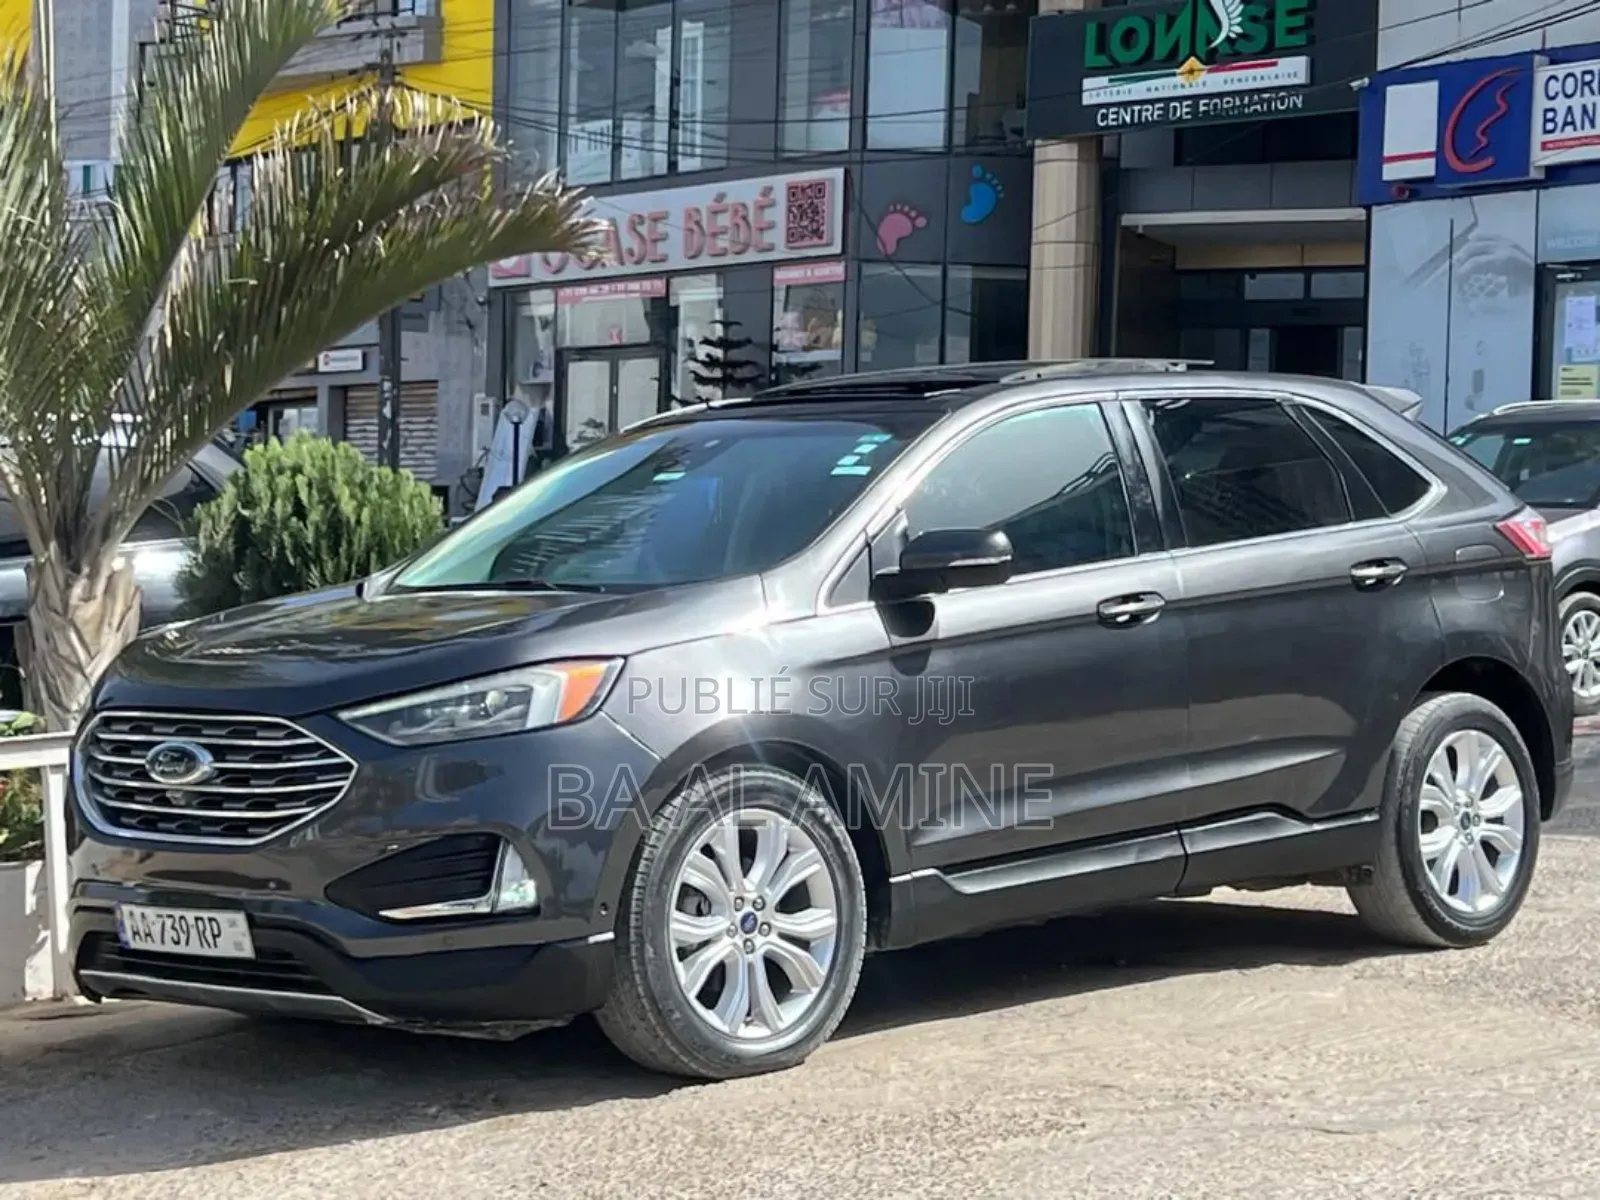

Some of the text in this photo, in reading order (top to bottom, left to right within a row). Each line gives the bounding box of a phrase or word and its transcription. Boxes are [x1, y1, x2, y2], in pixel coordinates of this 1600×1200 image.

[1544, 69, 1600, 101] COR
[1096, 92, 1303, 127] CENTRE DE FORMATION
[684, 186, 776, 259] BÉBÉ
